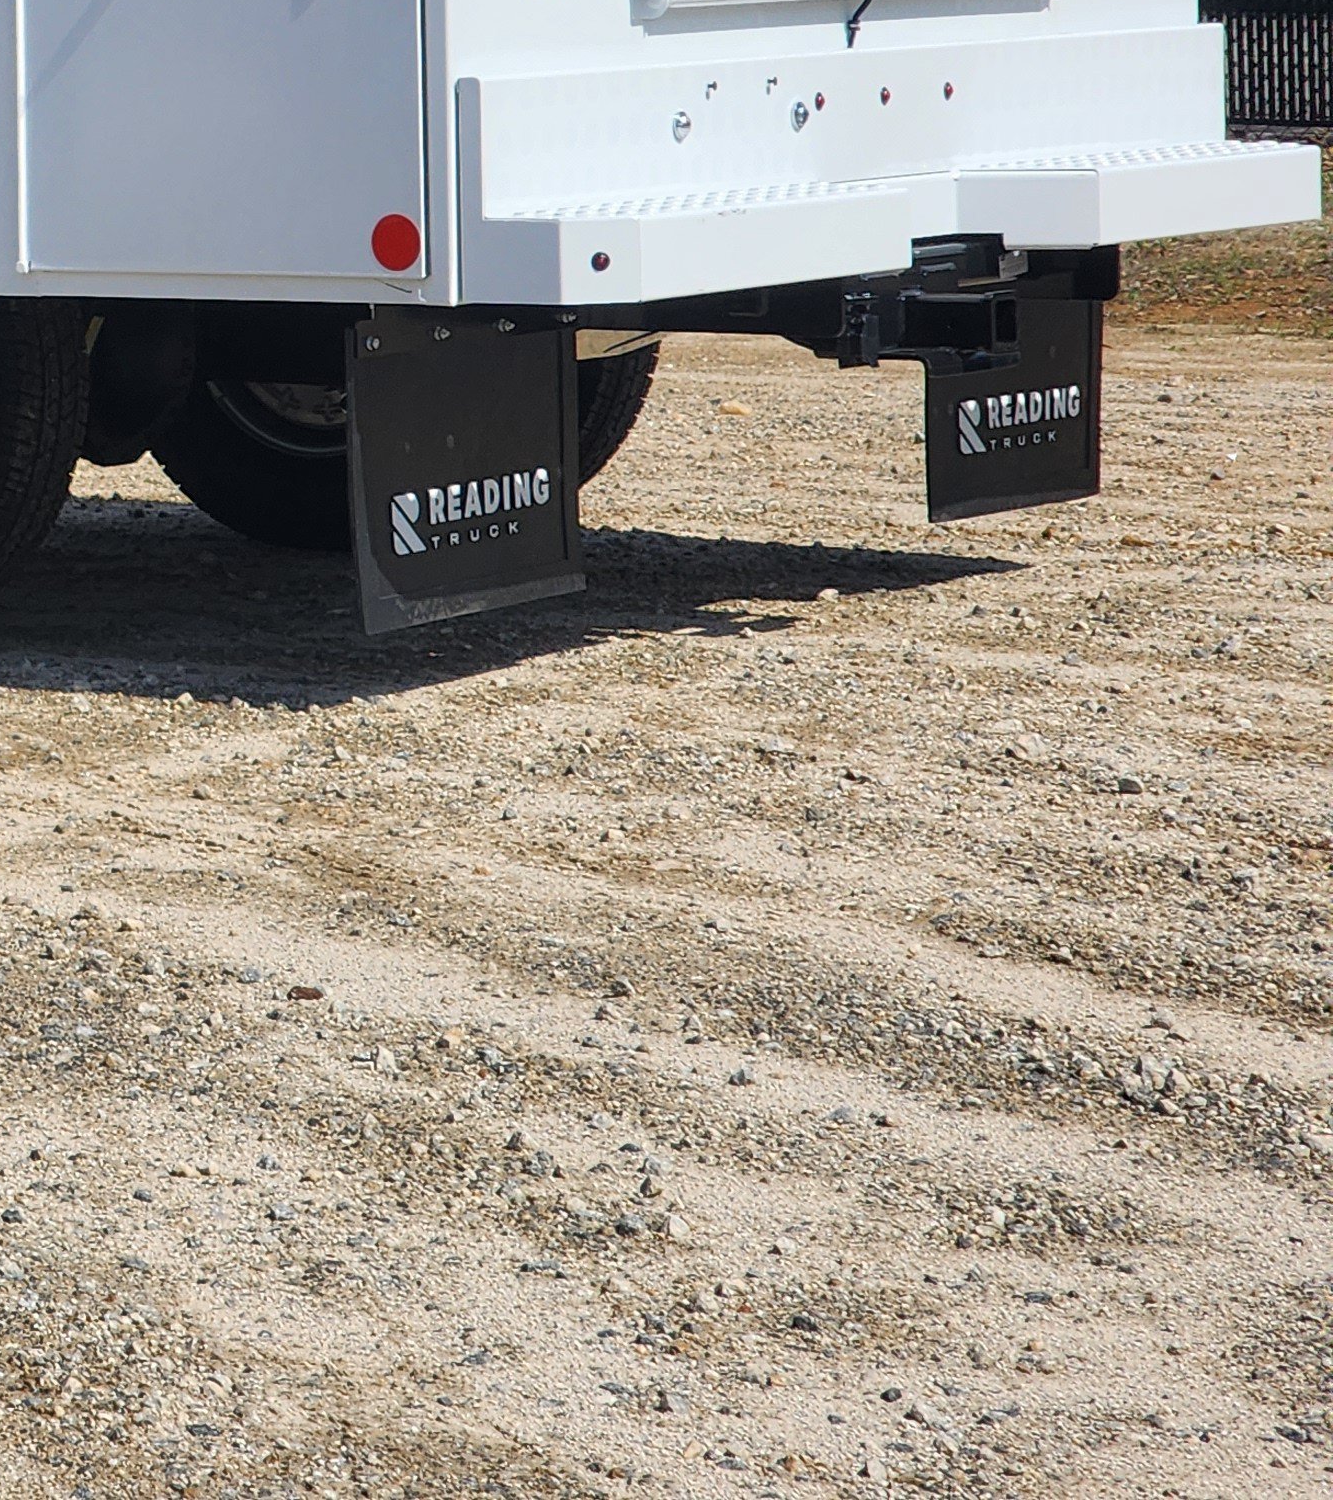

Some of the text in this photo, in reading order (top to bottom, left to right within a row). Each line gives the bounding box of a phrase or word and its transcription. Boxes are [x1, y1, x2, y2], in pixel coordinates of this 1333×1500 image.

[987, 385, 1081, 429] READING
[989, 431, 1057, 451] TRUCK
[429, 468, 550, 524] READING
[431, 522, 519, 550] TRUCK
